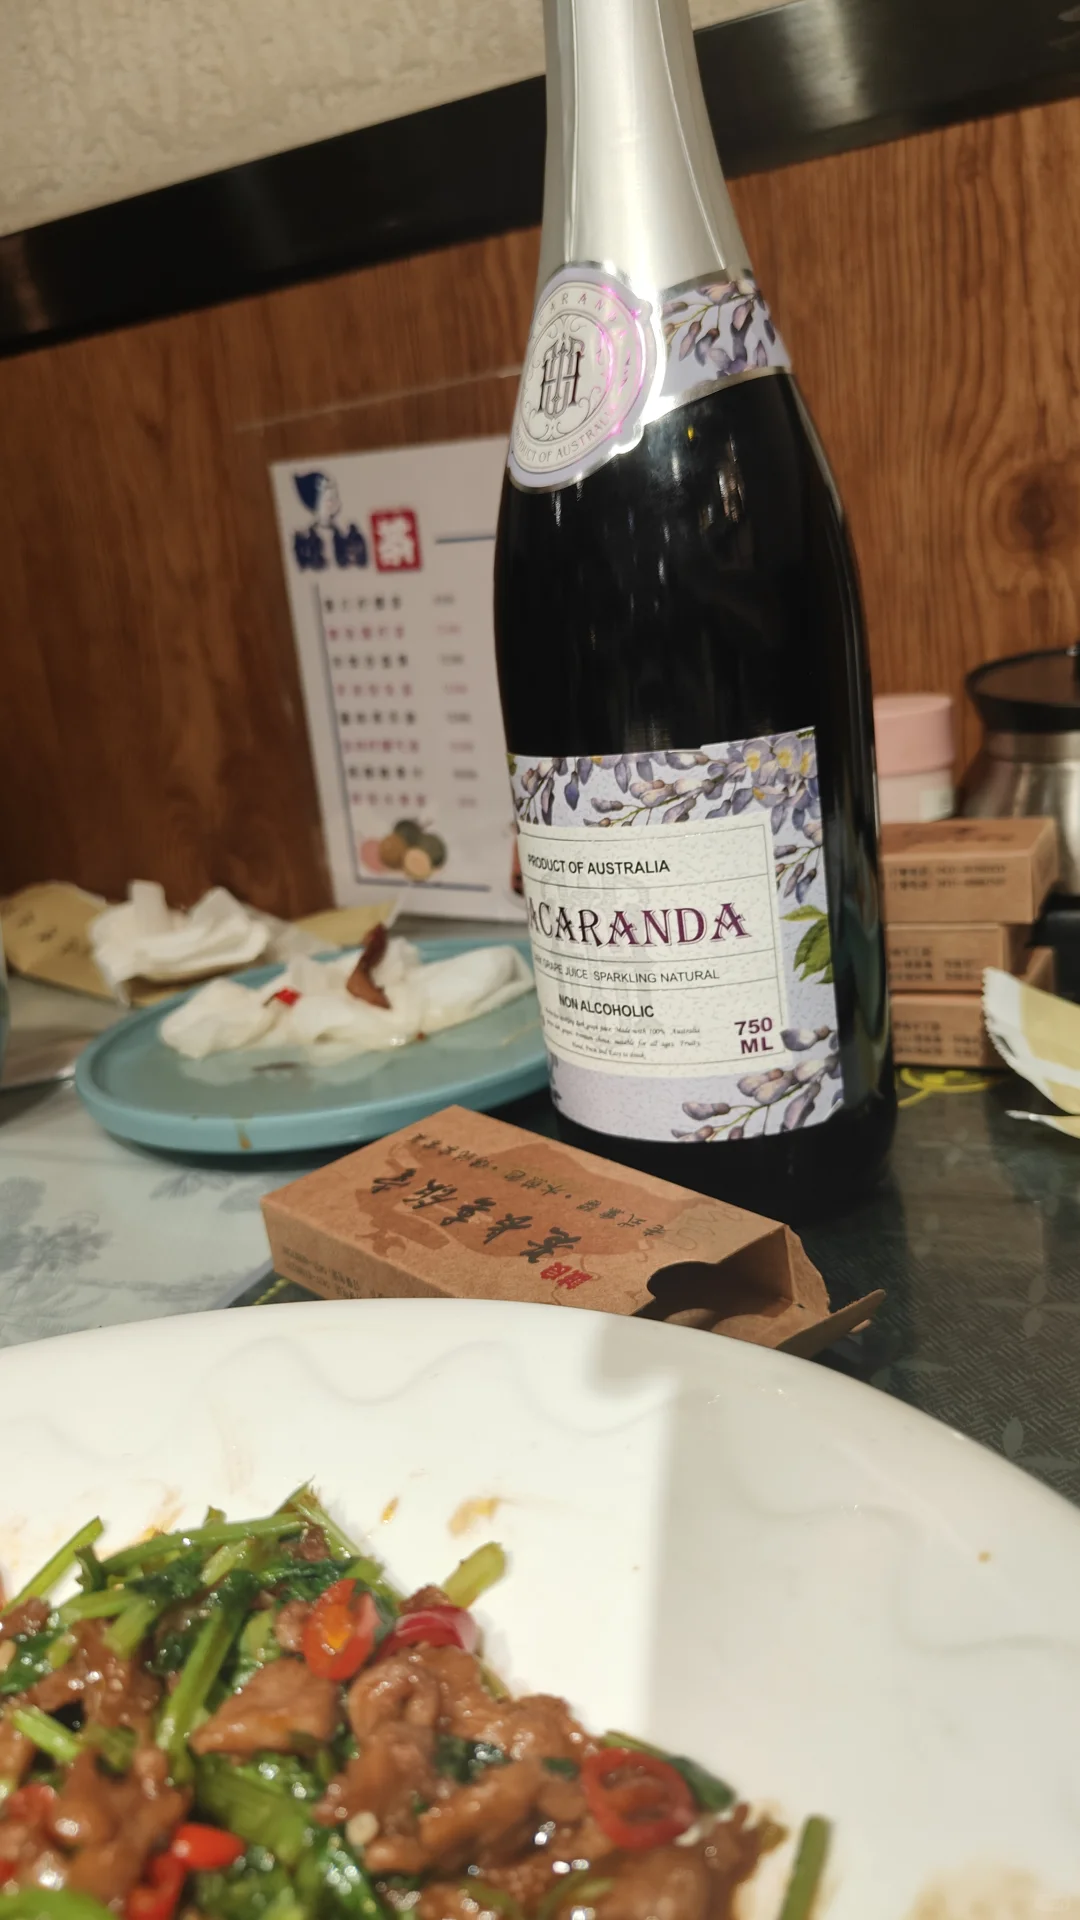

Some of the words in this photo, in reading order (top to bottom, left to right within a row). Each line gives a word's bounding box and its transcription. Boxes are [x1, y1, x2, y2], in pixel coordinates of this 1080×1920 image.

[528, 854, 566, 873] PRODUCT
[568, 861, 584, 874] OF
[587, 860, 671, 875] AUSTRALIA
[528, 897, 752, 948] ACARANDA
[565, 965, 588, 980] JUICE
[593, 970, 657, 984] SPARKLING
[660, 969, 720, 983] NATURAL
[558, 993, 578, 1010] NON
[580, 1001, 655, 1018] ALCOHOLIC
[734, 1017, 773, 1036] 750
[740, 1036, 774, 1054] ML
